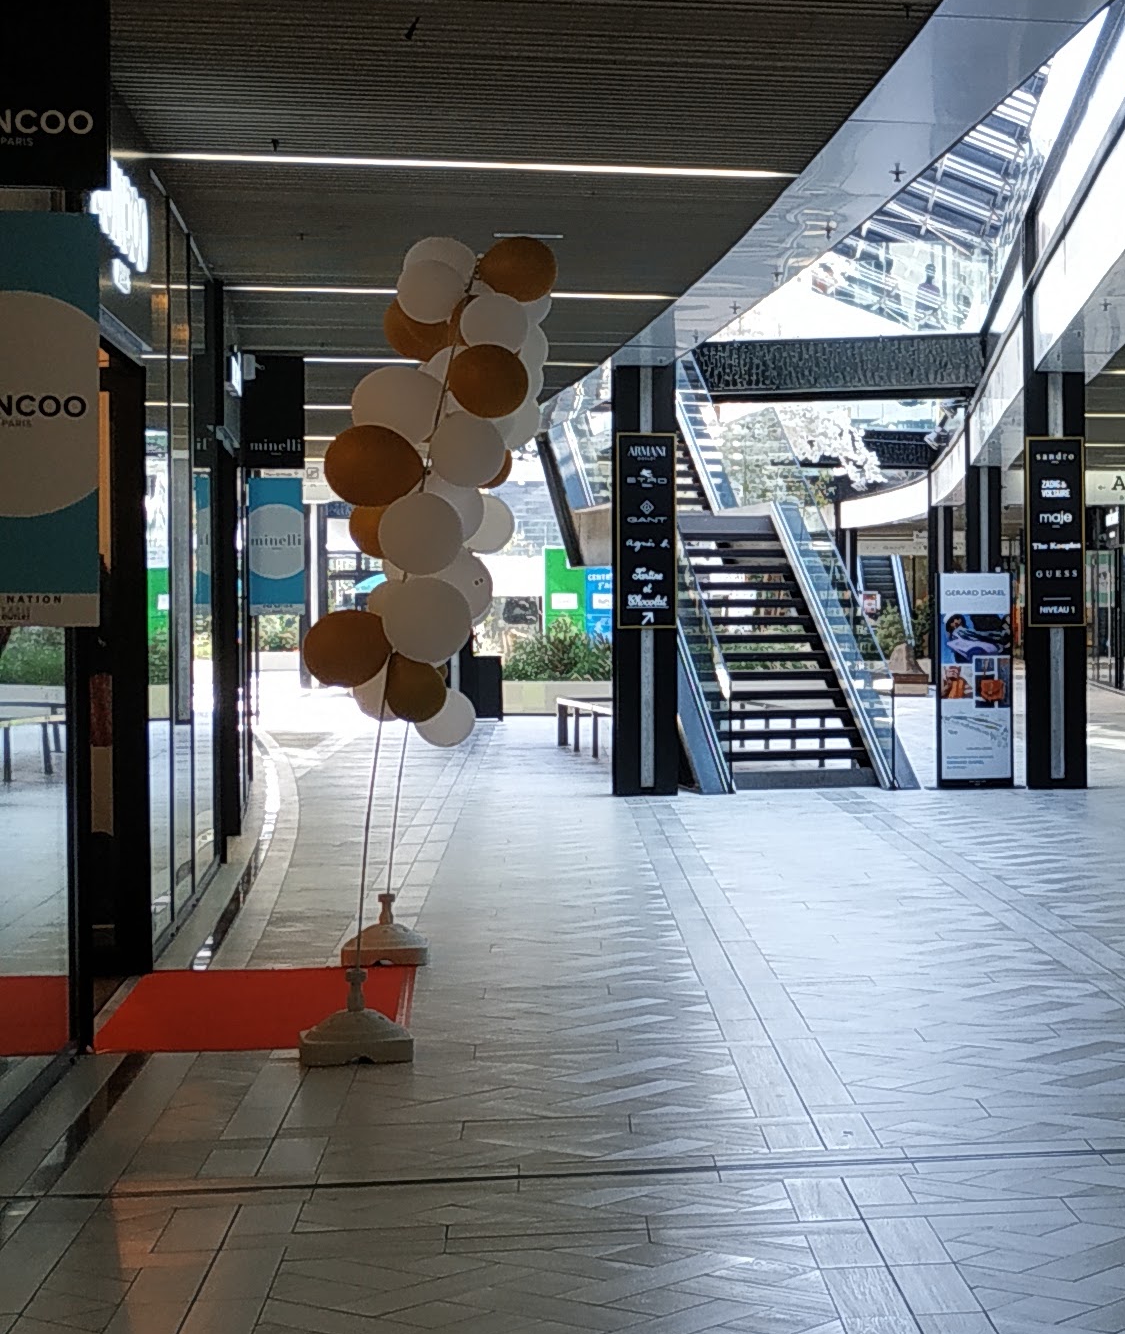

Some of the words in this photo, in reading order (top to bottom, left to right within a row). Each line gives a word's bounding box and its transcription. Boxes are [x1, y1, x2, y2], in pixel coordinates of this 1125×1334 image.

[0, 137, 34, 147] PARIS
[250, 438, 302, 452] minelli
[627, 445, 667, 457] ARMANI
[1036, 451, 1075, 460] sandro
[1039, 510, 1073, 524] maje
[251, 534, 302, 547] minelli
[1032, 542, 1049, 550] The
[1036, 570, 1078, 579] GUESS
[945, 589, 979, 597] GERARD
[981, 589, 1006, 597] DAREL
[6, 595, 63, 605] NATION
[1039, 605, 1069, 614] NIVEAU
[1071, 605, 1076, 614] 1
